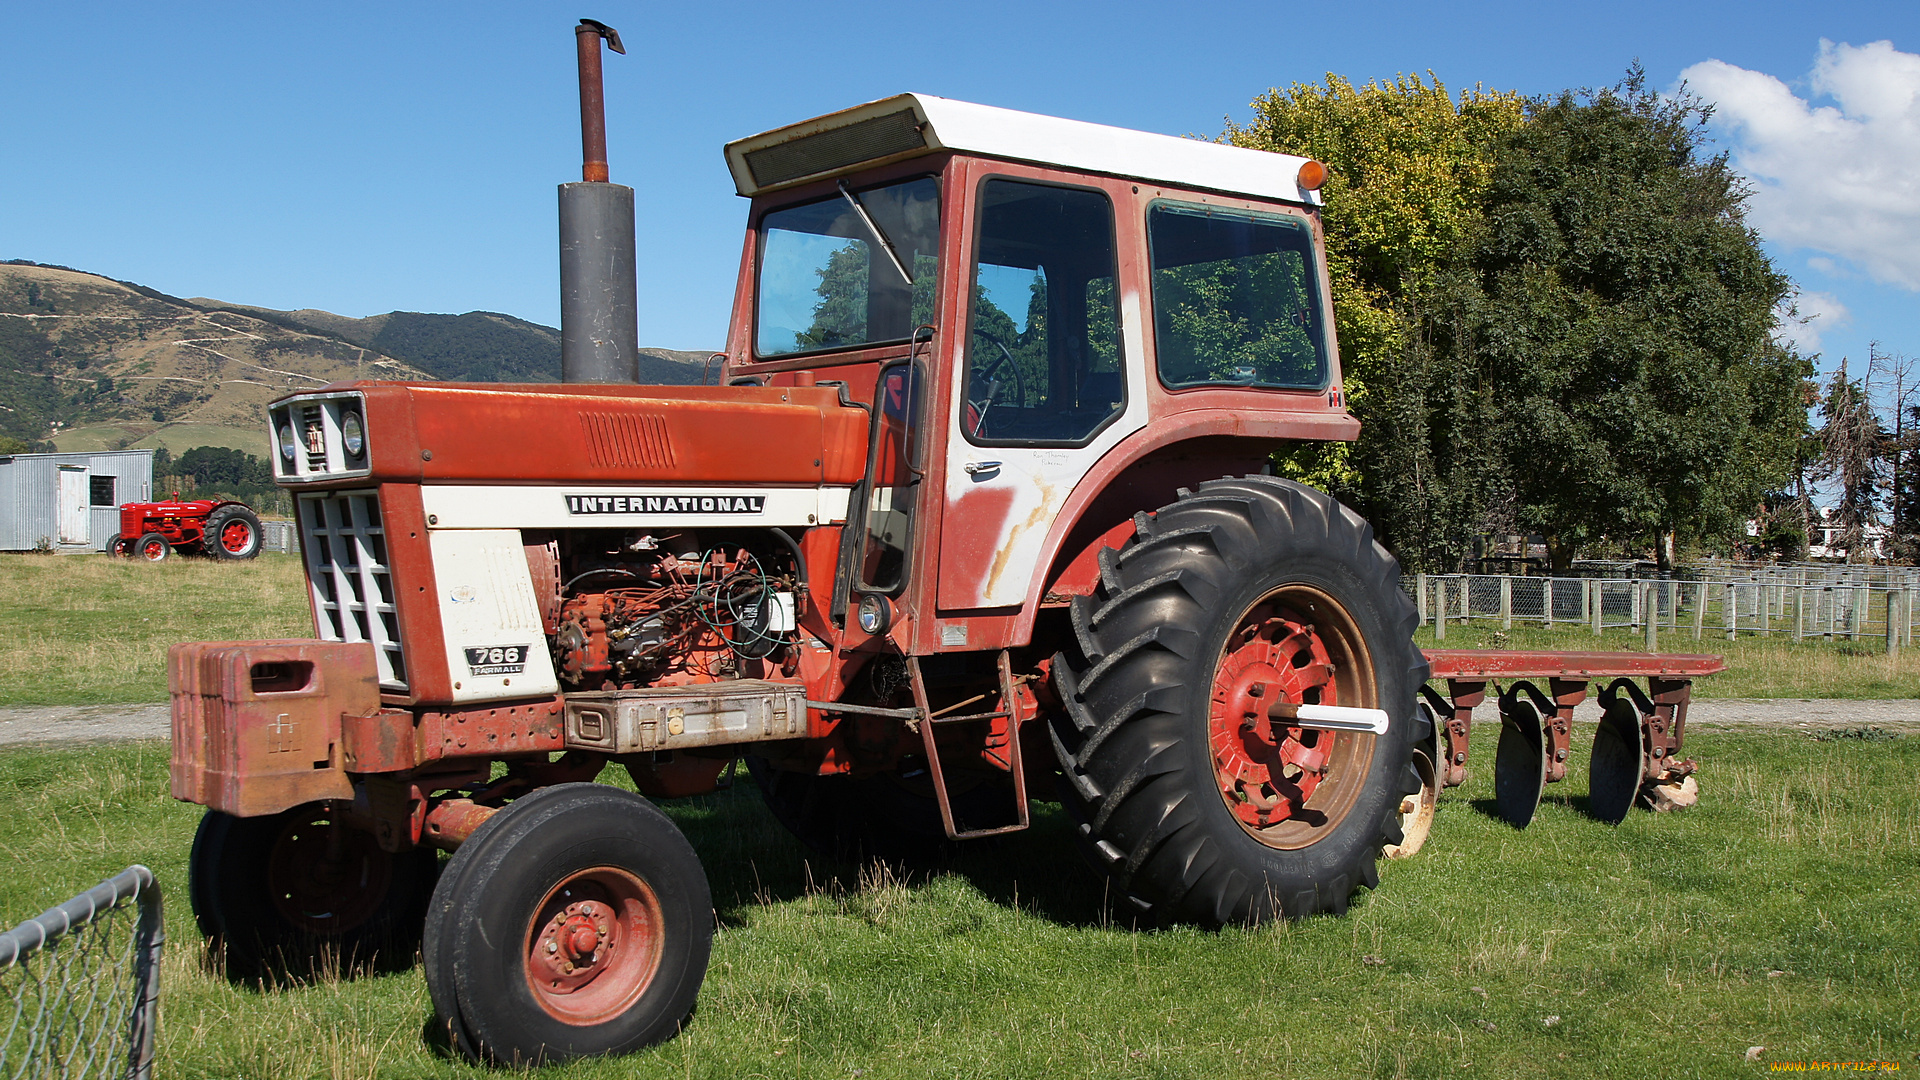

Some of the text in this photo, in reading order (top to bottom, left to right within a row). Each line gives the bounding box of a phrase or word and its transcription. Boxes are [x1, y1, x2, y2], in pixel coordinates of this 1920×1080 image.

[571, 496, 762, 512] INTERNATIONAL
[476, 647, 519, 664] 766
[474, 666, 521, 675] FARMALL
